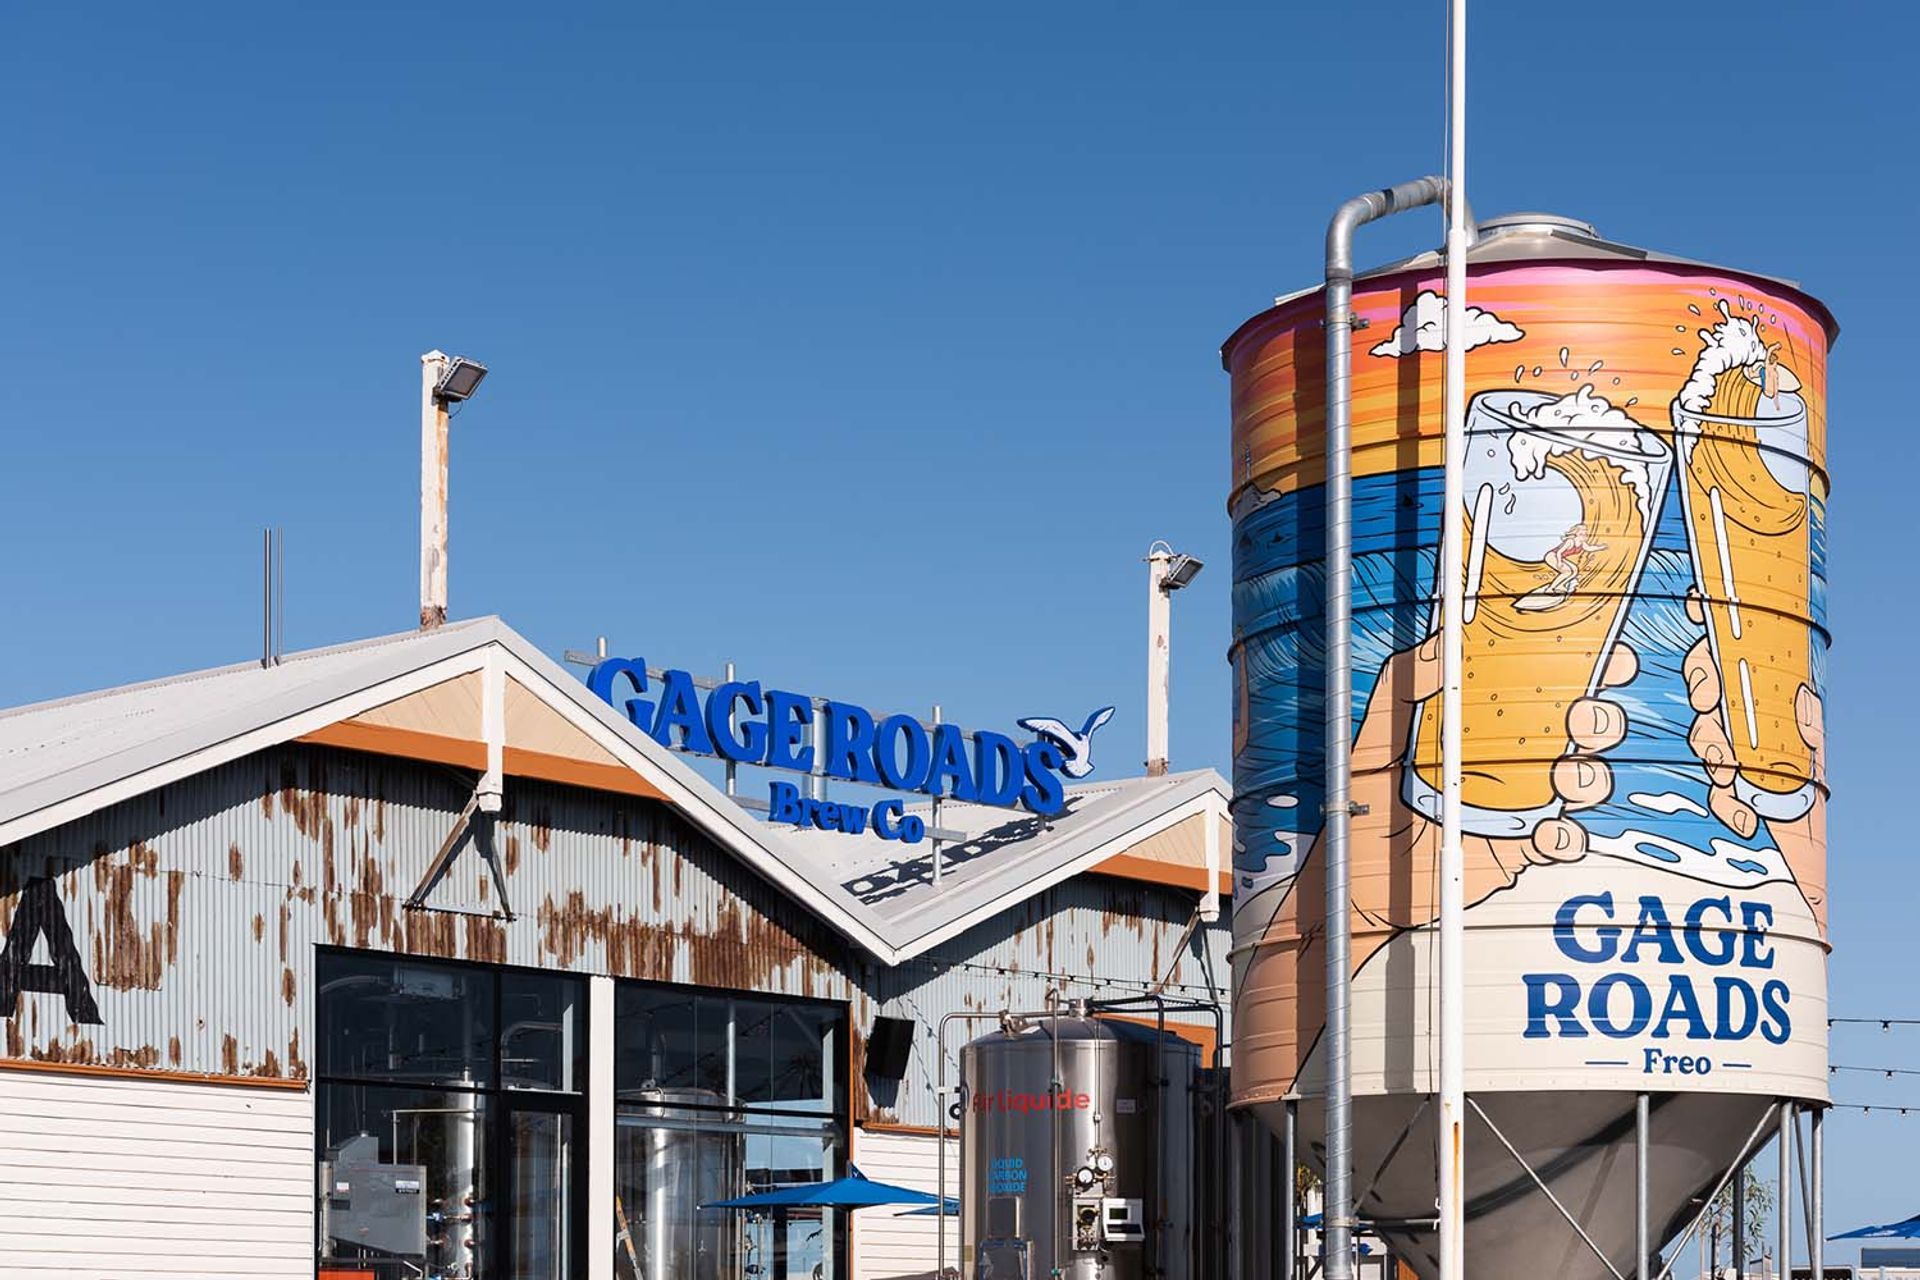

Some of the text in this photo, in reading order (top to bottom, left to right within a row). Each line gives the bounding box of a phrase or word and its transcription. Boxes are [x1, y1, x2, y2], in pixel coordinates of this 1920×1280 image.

[586, 657, 1065, 816] GAGE ROADS
[768, 781, 925, 844] Brew Co
[1552, 891, 1775, 970] GAGE
[1521, 972, 1792, 1046] ROADS
[1643, 1048, 1712, 1075] Freo
